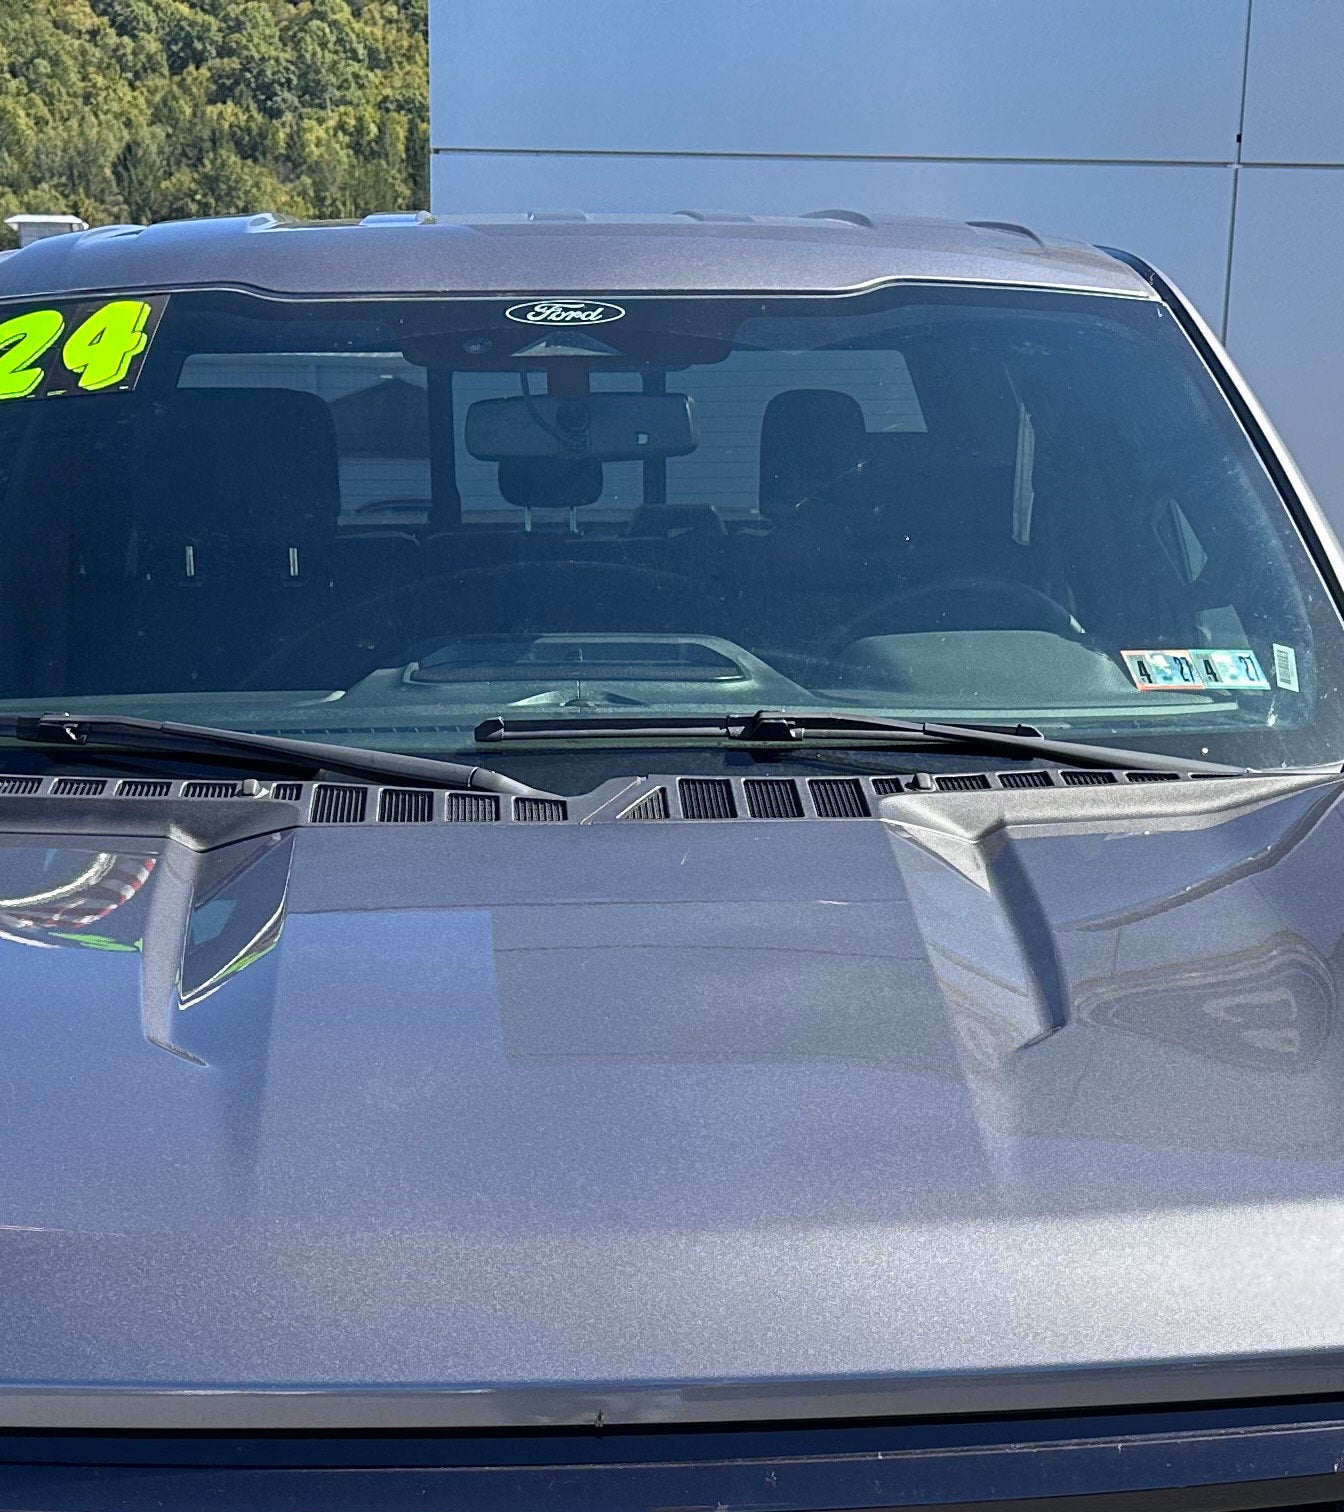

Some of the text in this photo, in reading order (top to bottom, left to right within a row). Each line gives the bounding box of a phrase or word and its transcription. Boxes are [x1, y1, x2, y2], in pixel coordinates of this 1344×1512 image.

[526, 303, 604, 321] Ford
[1137, 660, 1154, 684] 4
[1203, 659, 1219, 683] 4
